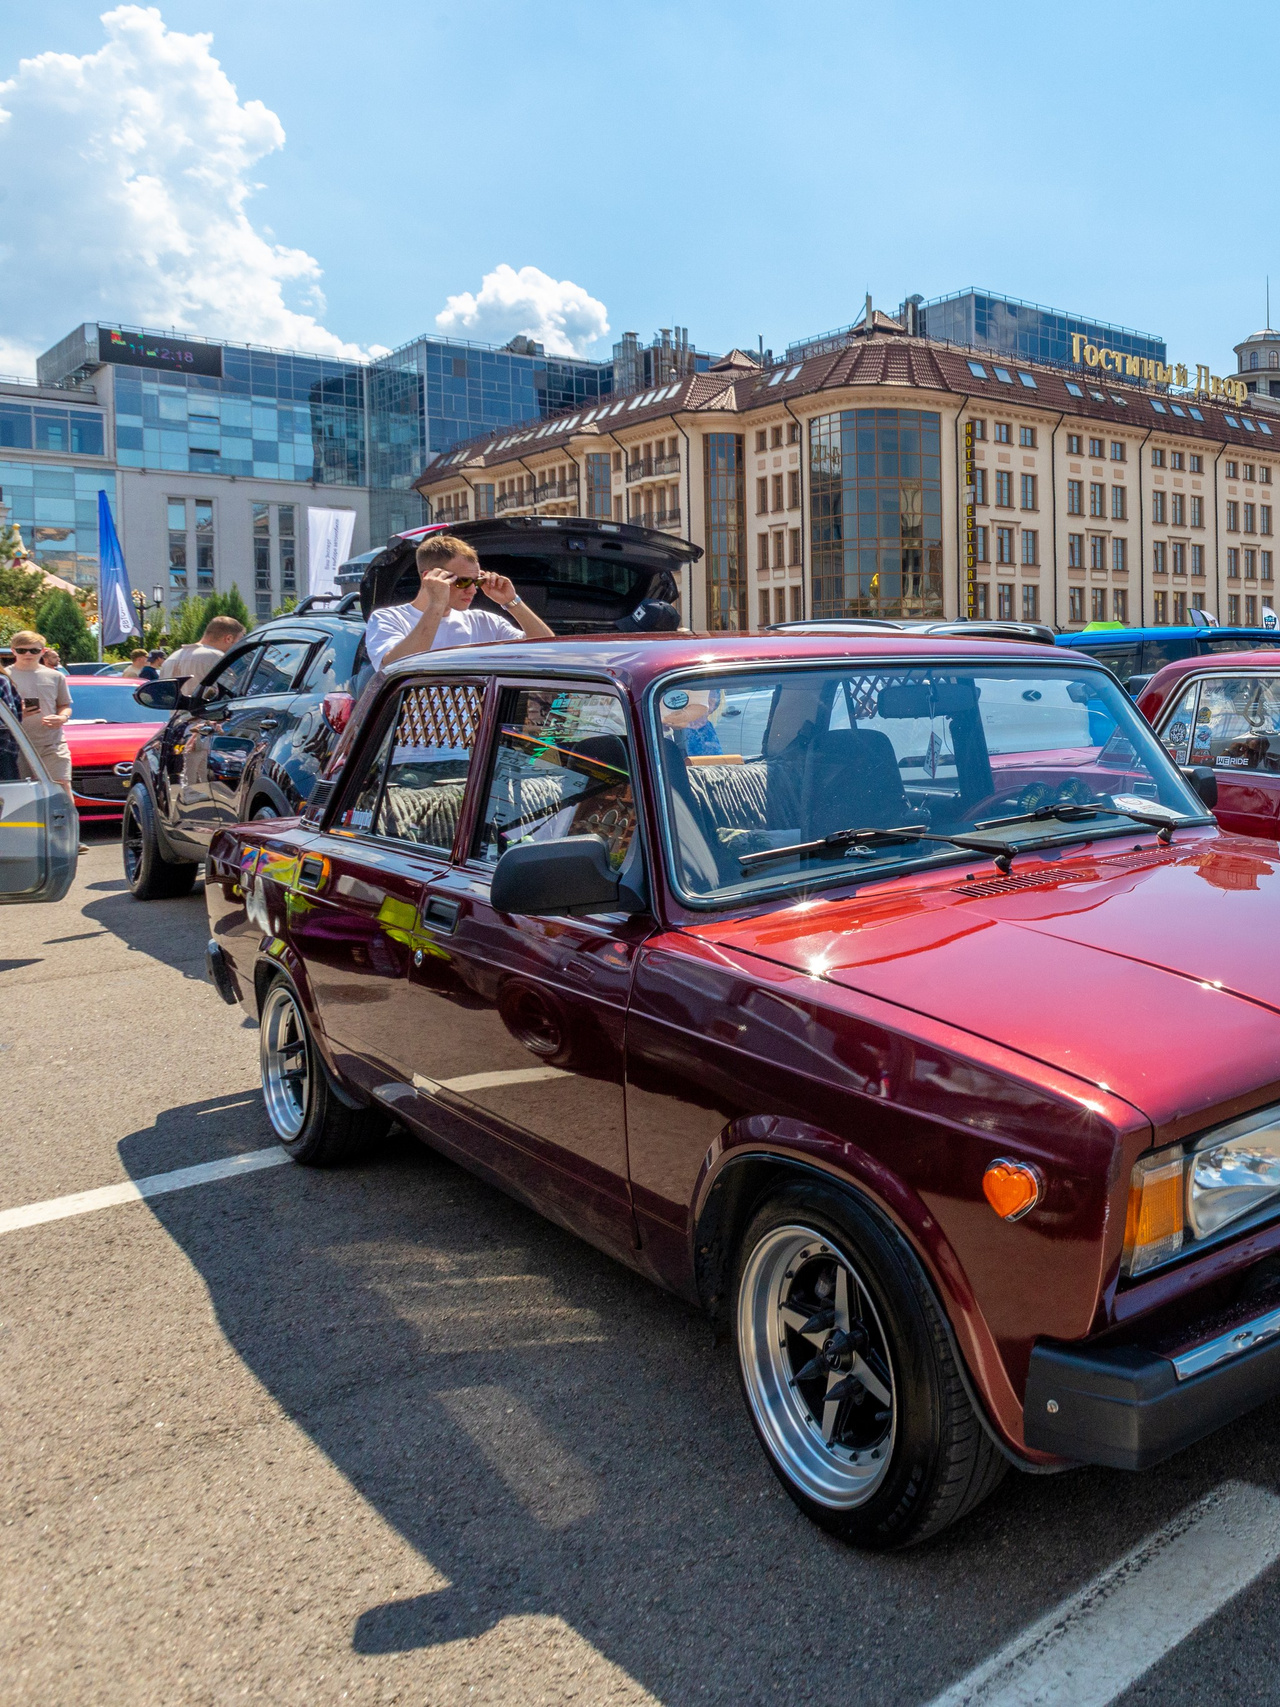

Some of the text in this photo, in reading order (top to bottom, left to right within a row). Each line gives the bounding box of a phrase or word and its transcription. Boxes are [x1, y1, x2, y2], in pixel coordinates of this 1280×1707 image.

[1070, 332, 1248, 407] Гостиный Двор
[966, 504, 974, 618] ESTAURANT
[1230, 757, 1249, 766] RIDE
